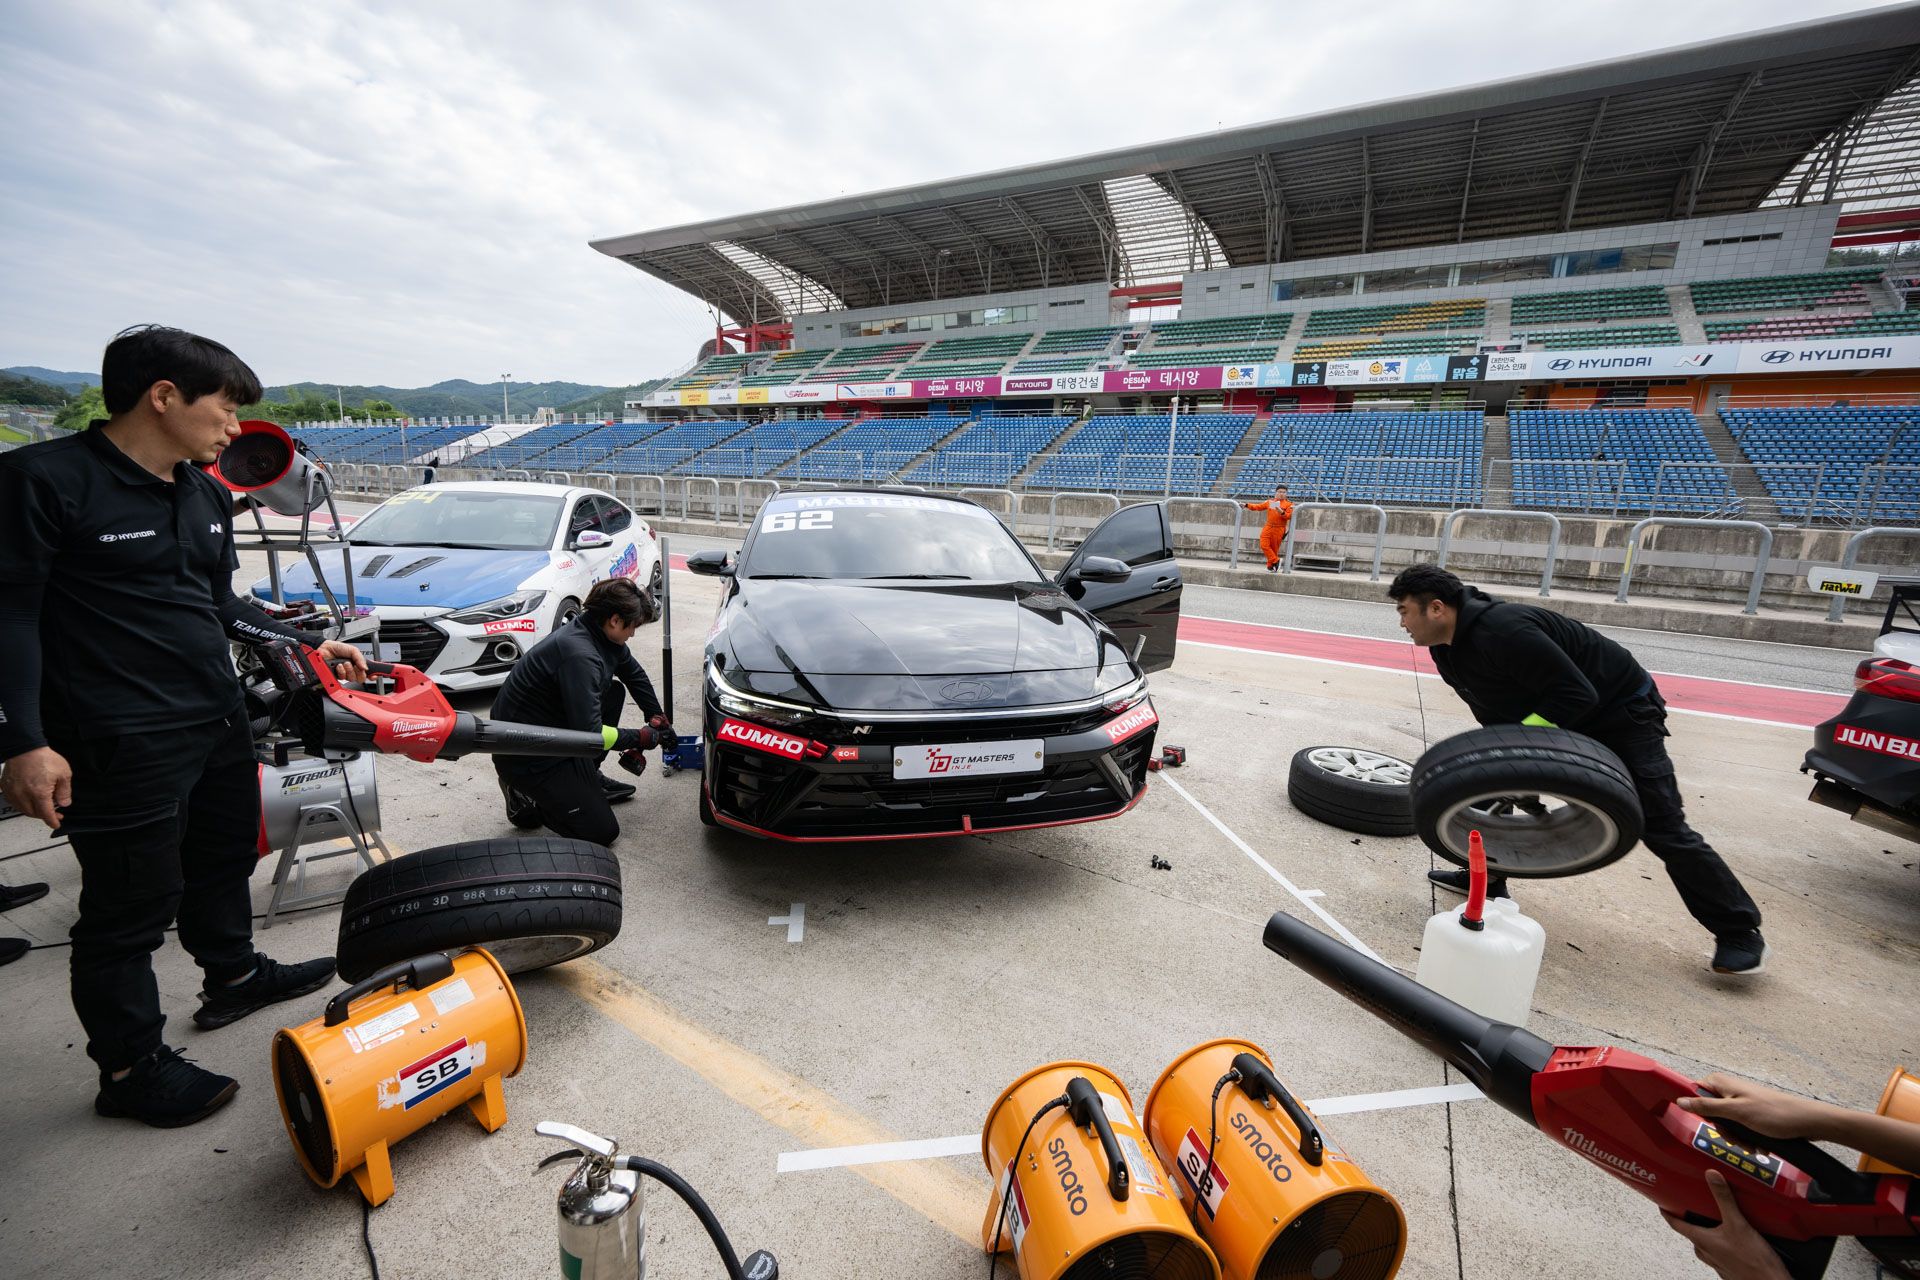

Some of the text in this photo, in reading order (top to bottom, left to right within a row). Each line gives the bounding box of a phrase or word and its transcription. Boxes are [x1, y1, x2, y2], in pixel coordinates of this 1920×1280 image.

[1799, 347, 1893, 362] HYUNDAI
[1512, 363, 1527, 371] 인제
[1578, 356, 1652, 369] HYUNDAI
[1123, 376, 1151, 384] DESIAN
[1160, 370, 1200, 386] 데시앙
[1297, 372, 1319, 385] 맑음
[1452, 367, 1479, 380] 맑음
[927, 384, 949, 392] DESIAN
[955, 379, 985, 393] 데시앙
[1010, 381, 1048, 389] TAEYOUNG
[1056, 376, 1099, 390] 태영건설
[799, 497, 942, 510] MASTERS
[210, 523, 223, 534] N
[761, 510, 834, 533] 62
[118, 530, 157, 541] HYUNDAI
[232, 619, 260, 635] TEAM
[485, 621, 534, 633] KUMHO
[392, 719, 438, 733] Milwaukee
[1107, 708, 1156, 739] KUMHO
[720, 723, 804, 754] KUMHO
[1837, 728, 1885, 750] JUN
[952, 754, 1015, 764] GT MASTERS
[432, 895, 449, 906] 3D
[571, 884, 583, 893] 40
[416, 1057, 459, 1090] SB
[1230, 1112, 1292, 1183] smato
[1562, 1127, 1657, 1183] Milwaukee
[1048, 1137, 1088, 1217] smato
[1187, 1151, 1214, 1197] SB
